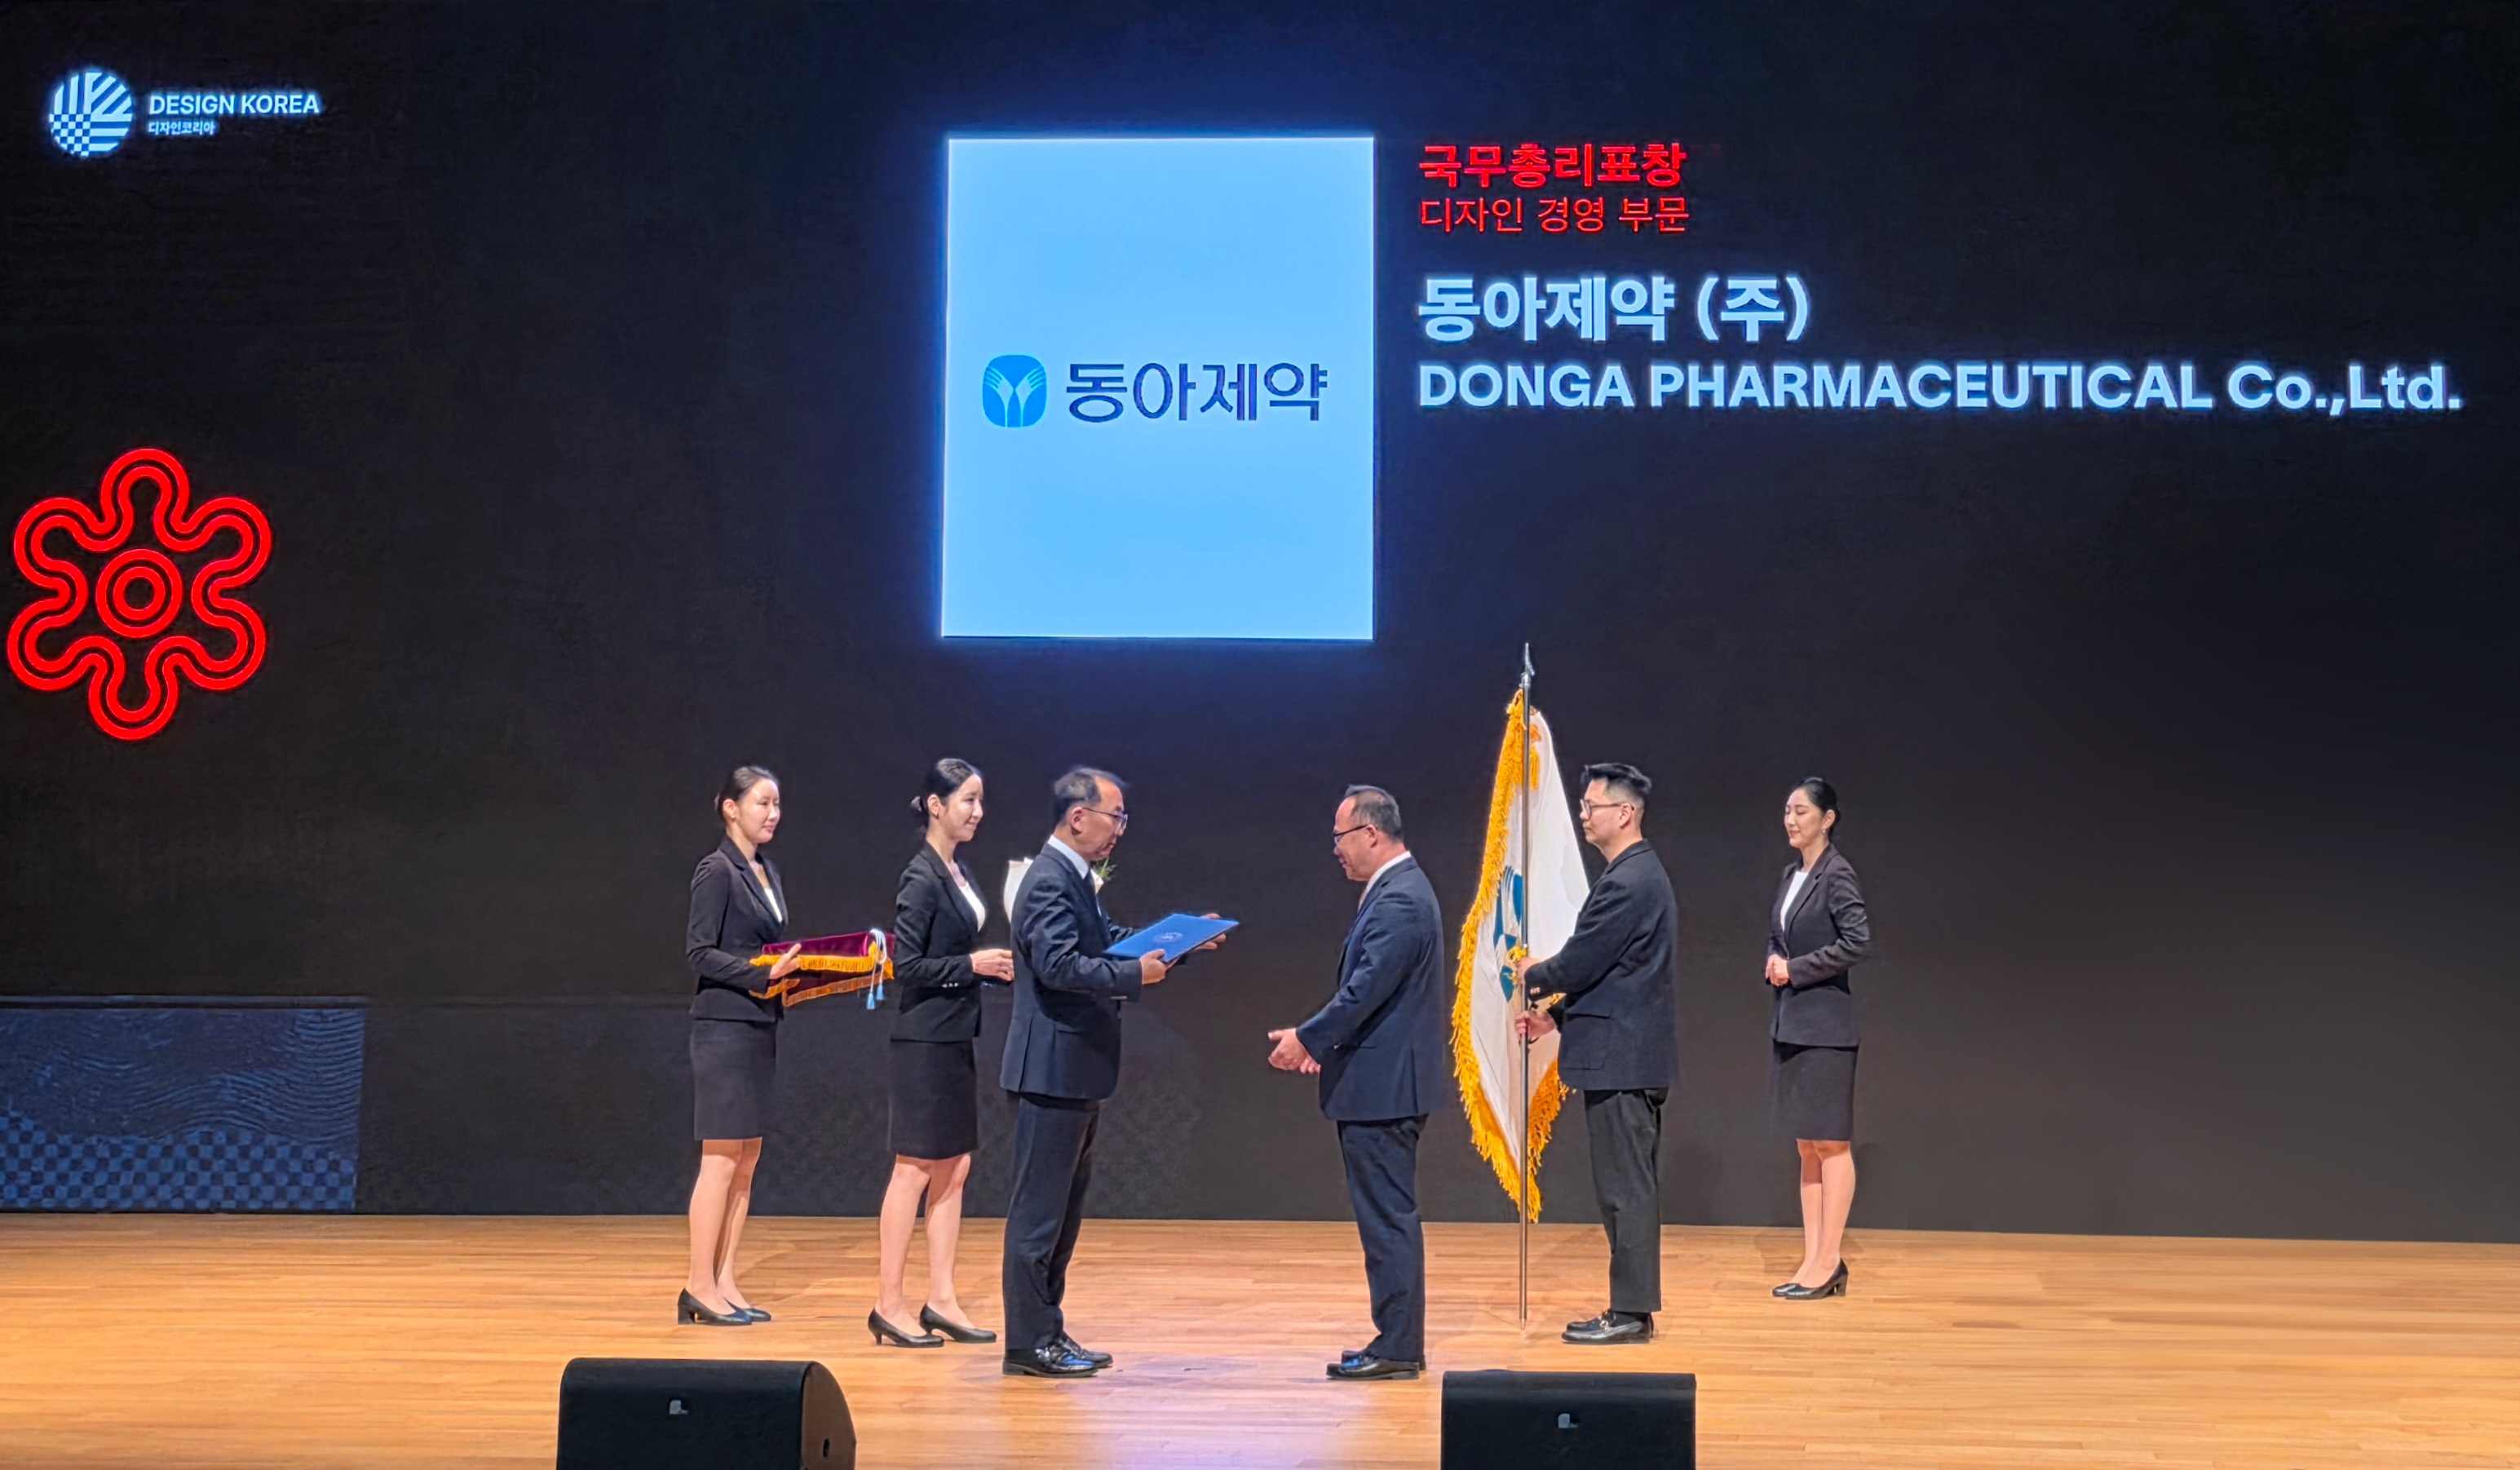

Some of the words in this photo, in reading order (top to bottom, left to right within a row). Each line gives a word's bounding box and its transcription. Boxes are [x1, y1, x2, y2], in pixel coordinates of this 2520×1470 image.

[149, 95, 235, 114] DESIGN
[241, 95, 320, 113] KOREA
[148, 121, 215, 135] 디자인코리아
[1419, 143, 1687, 187] 국무총리표창
[1420, 197, 1523, 232] 디자인
[1536, 197, 1606, 232] 경영
[1618, 197, 1689, 232] 부문
[1418, 276, 1675, 342] 동아제약
[1697, 277, 1809, 341] (주)
[1066, 362, 1329, 423] 동아제약
[1420, 364, 1634, 408] DONGA
[1650, 364, 2213, 409] PHARMACEUTICAL
[2227, 363, 2462, 416] Co.,Ltd.
